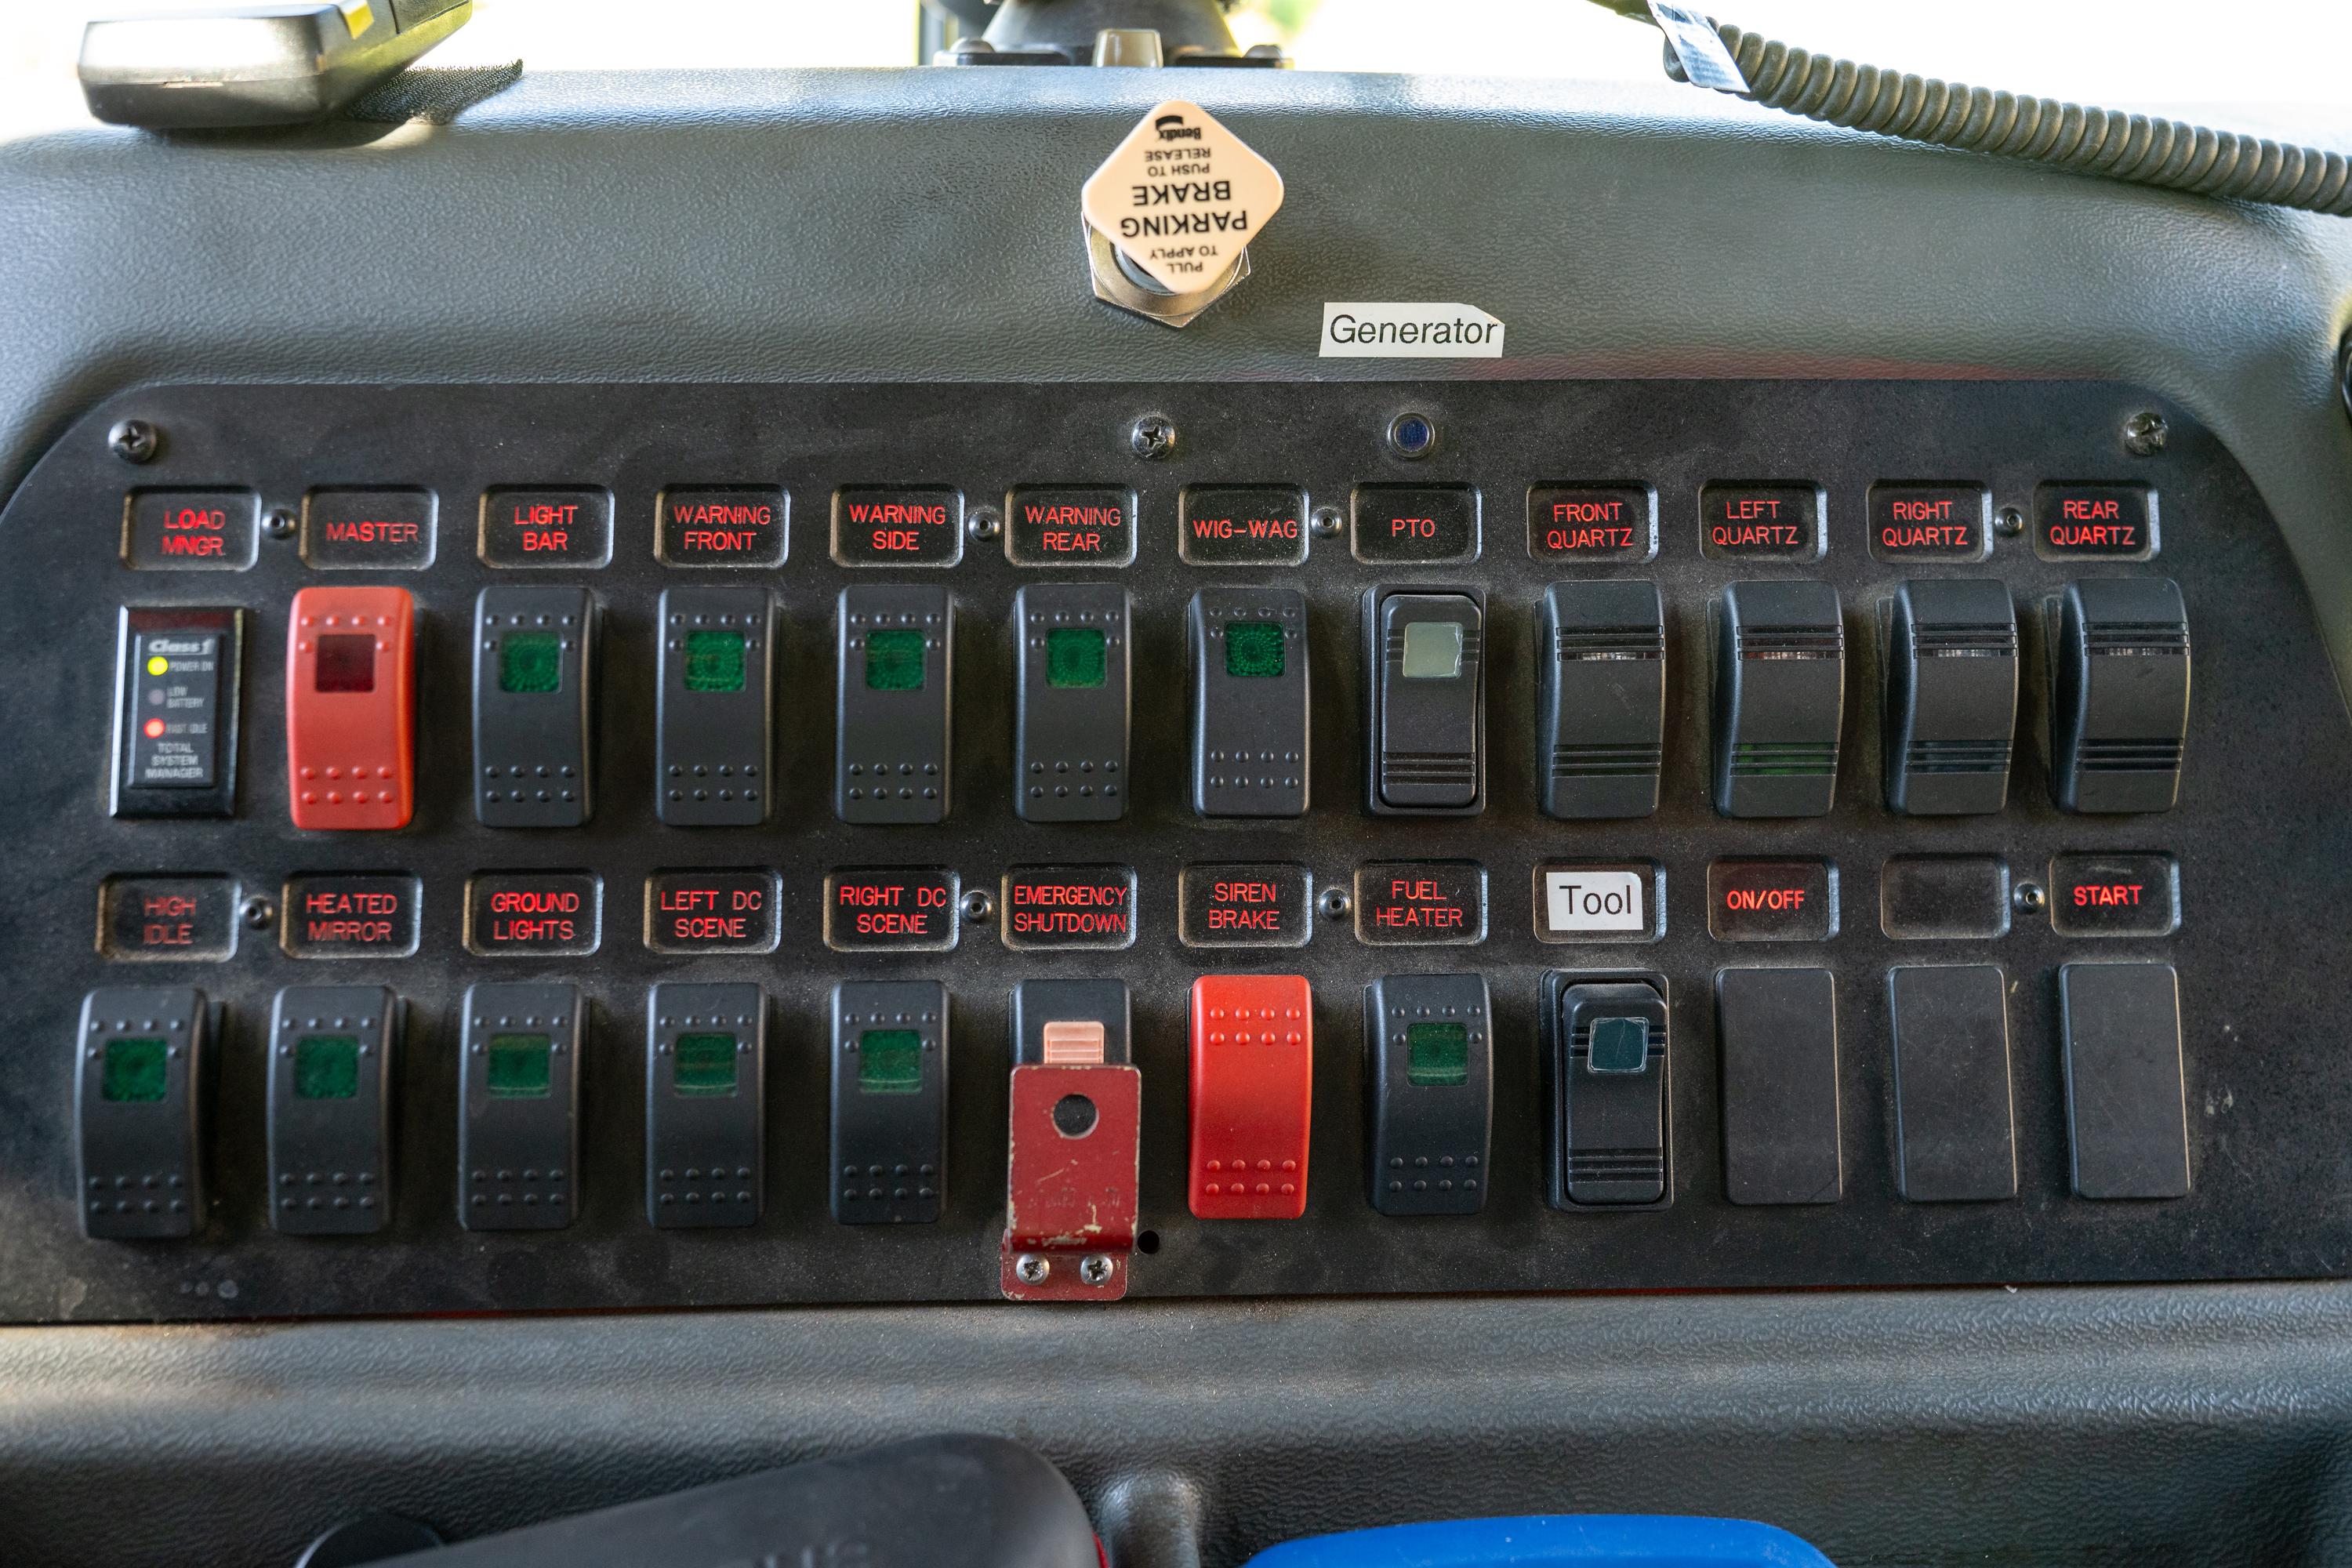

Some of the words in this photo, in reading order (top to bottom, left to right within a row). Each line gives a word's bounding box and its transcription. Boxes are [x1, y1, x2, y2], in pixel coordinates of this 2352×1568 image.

[1158, 127, 1202, 143] Bendix
[1144, 147, 1211, 162] RELEASE
[1147, 165, 1167, 178] TO
[1171, 162, 1210, 176] PUSH
[1132, 180, 1231, 207] BRAKE
[1120, 210, 1248, 238] PARKING
[1149, 246, 1196, 261] APPLY
[1198, 245, 1219, 257] TO
[1165, 261, 1204, 274] PULL
[1330, 314, 1498, 344] Generator
[163, 508, 226, 531] LOAD
[514, 504, 579, 526] LIGHT
[673, 503, 771, 526] WARNING
[848, 503, 946, 525] WARNING
[1025, 505, 1122, 527] WARNING
[1552, 501, 1623, 523] FRONT
[1726, 499, 1781, 520] LEFT
[1893, 500, 1953, 521] RIGHT
[2063, 499, 2119, 520] REAR
[325, 520, 419, 543] MASTER
[1192, 518, 1298, 539] WIG-WAG
[1392, 517, 1436, 538] PTO
[1546, 526, 1634, 550] QUARTZ
[1711, 525, 1799, 547] QUARTZ
[1882, 525, 1969, 548] QUARTZ
[2049, 524, 2136, 546] QUARTZ
[162, 534, 224, 556] MNGR
[522, 530, 568, 551] BAR
[684, 530, 757, 551] FRONT
[872, 529, 920, 550] SIDE
[1042, 530, 1101, 552] REAR
[169, 661, 201, 672] POWER
[200, 661, 214, 672] ON
[166, 686, 188, 697] LOW
[158, 742, 195, 753] TOTAL
[151, 754, 199, 767] SYSTEM
[144, 767, 204, 779] MANAGER
[660, 889, 720, 911] LEFT
[731, 890, 762, 911] DC
[839, 884, 905, 906] RIGHT
[916, 886, 947, 908] DC
[1013, 884, 1127, 906] EMERGENCY
[1214, 881, 1276, 903] SIREN
[1391, 879, 1447, 901] FUEL
[1559, 884, 1632, 916] Tool
[1725, 887, 1806, 911] ON/OFF
[2072, 884, 2143, 906] START
[145, 895, 196, 917] HIGH
[306, 892, 397, 915] HEATED
[490, 891, 580, 914] GROUND
[673, 916, 747, 938] SCENE
[856, 912, 928, 935] SCENE
[1013, 911, 1127, 933] SHUTDOWN
[1208, 908, 1280, 930] BRAKE
[1375, 906, 1463, 928] HEATER
[143, 923, 194, 945] IDLE
[308, 920, 393, 942] MIRROR
[493, 918, 575, 941] LIGHTS
